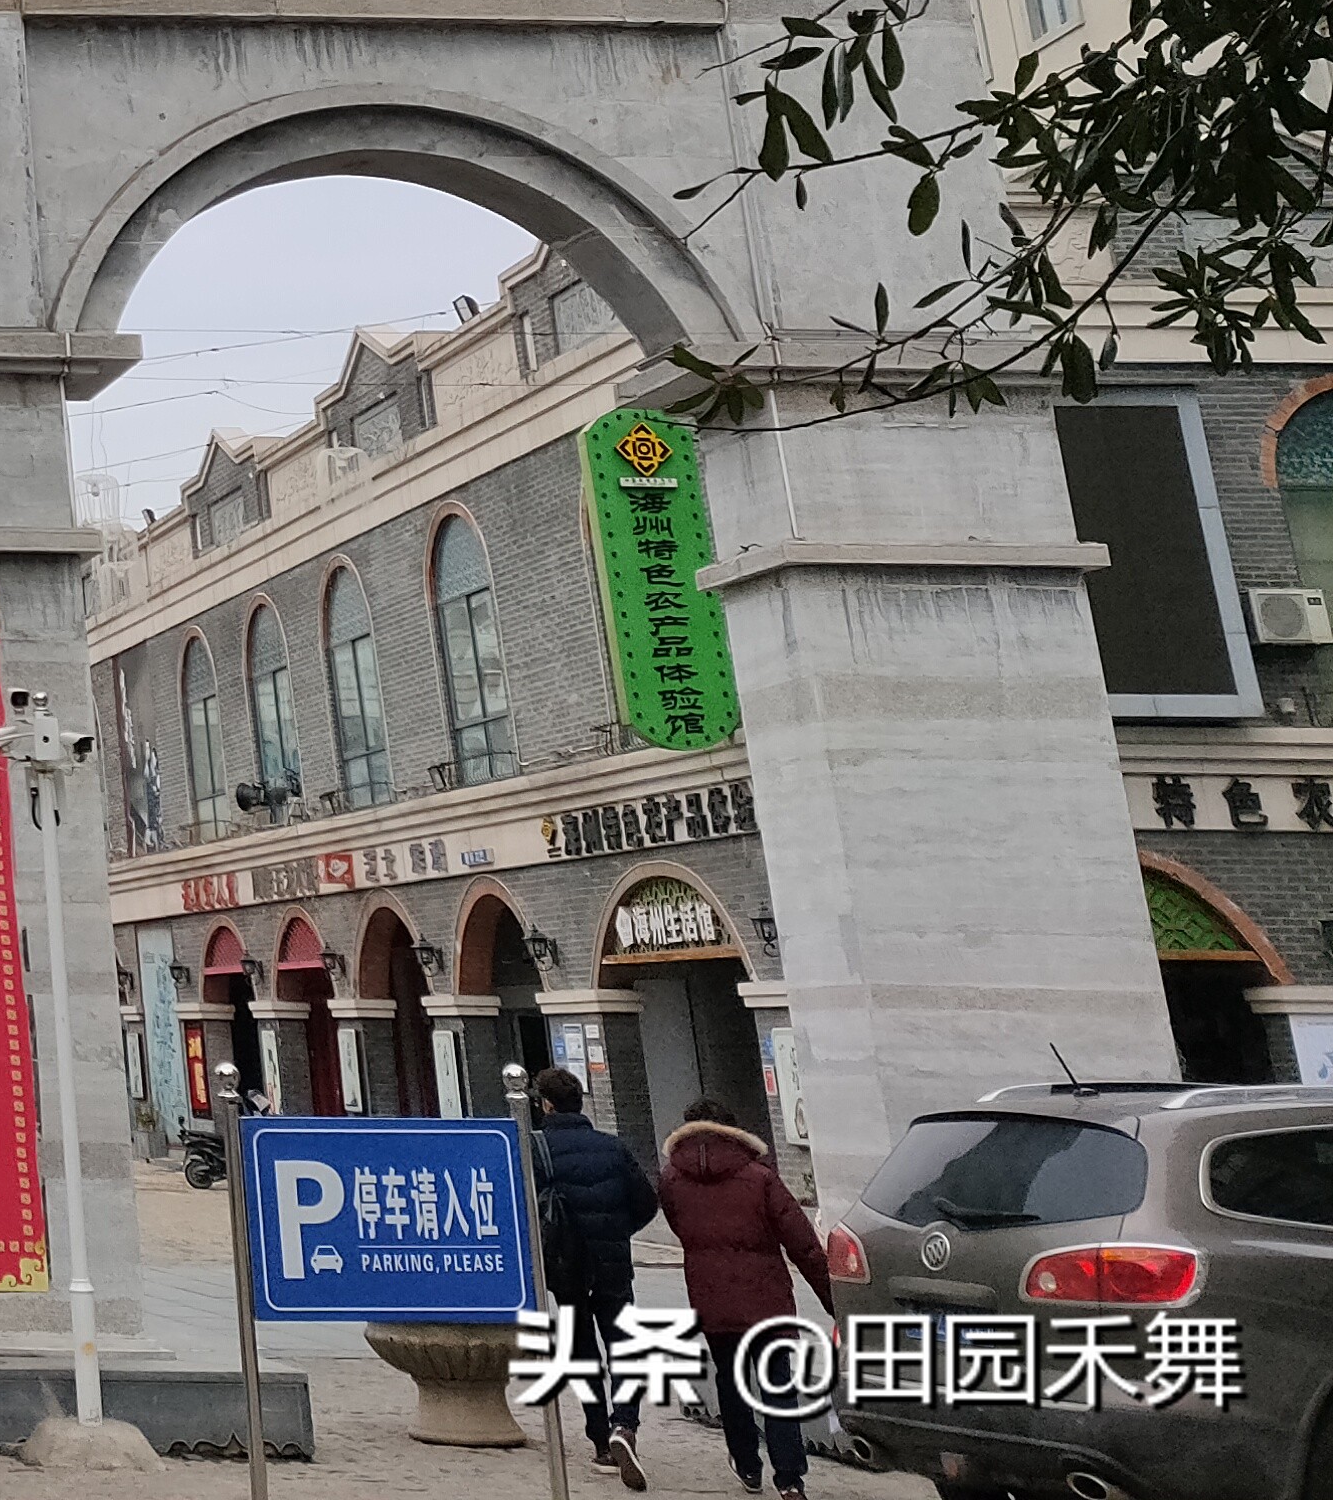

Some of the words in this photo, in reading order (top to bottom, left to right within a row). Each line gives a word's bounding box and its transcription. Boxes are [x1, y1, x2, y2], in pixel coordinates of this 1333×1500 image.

[628, 492, 706, 736] 海州特色农产品体验馆
[1151, 774, 1333, 832] 特色农
[632, 900, 716, 946] 海州生活馆
[274, 1160, 345, 1279] P
[353, 1166, 499, 1240] 停车请入位
[444, 1254, 504, 1272] PLEASE
